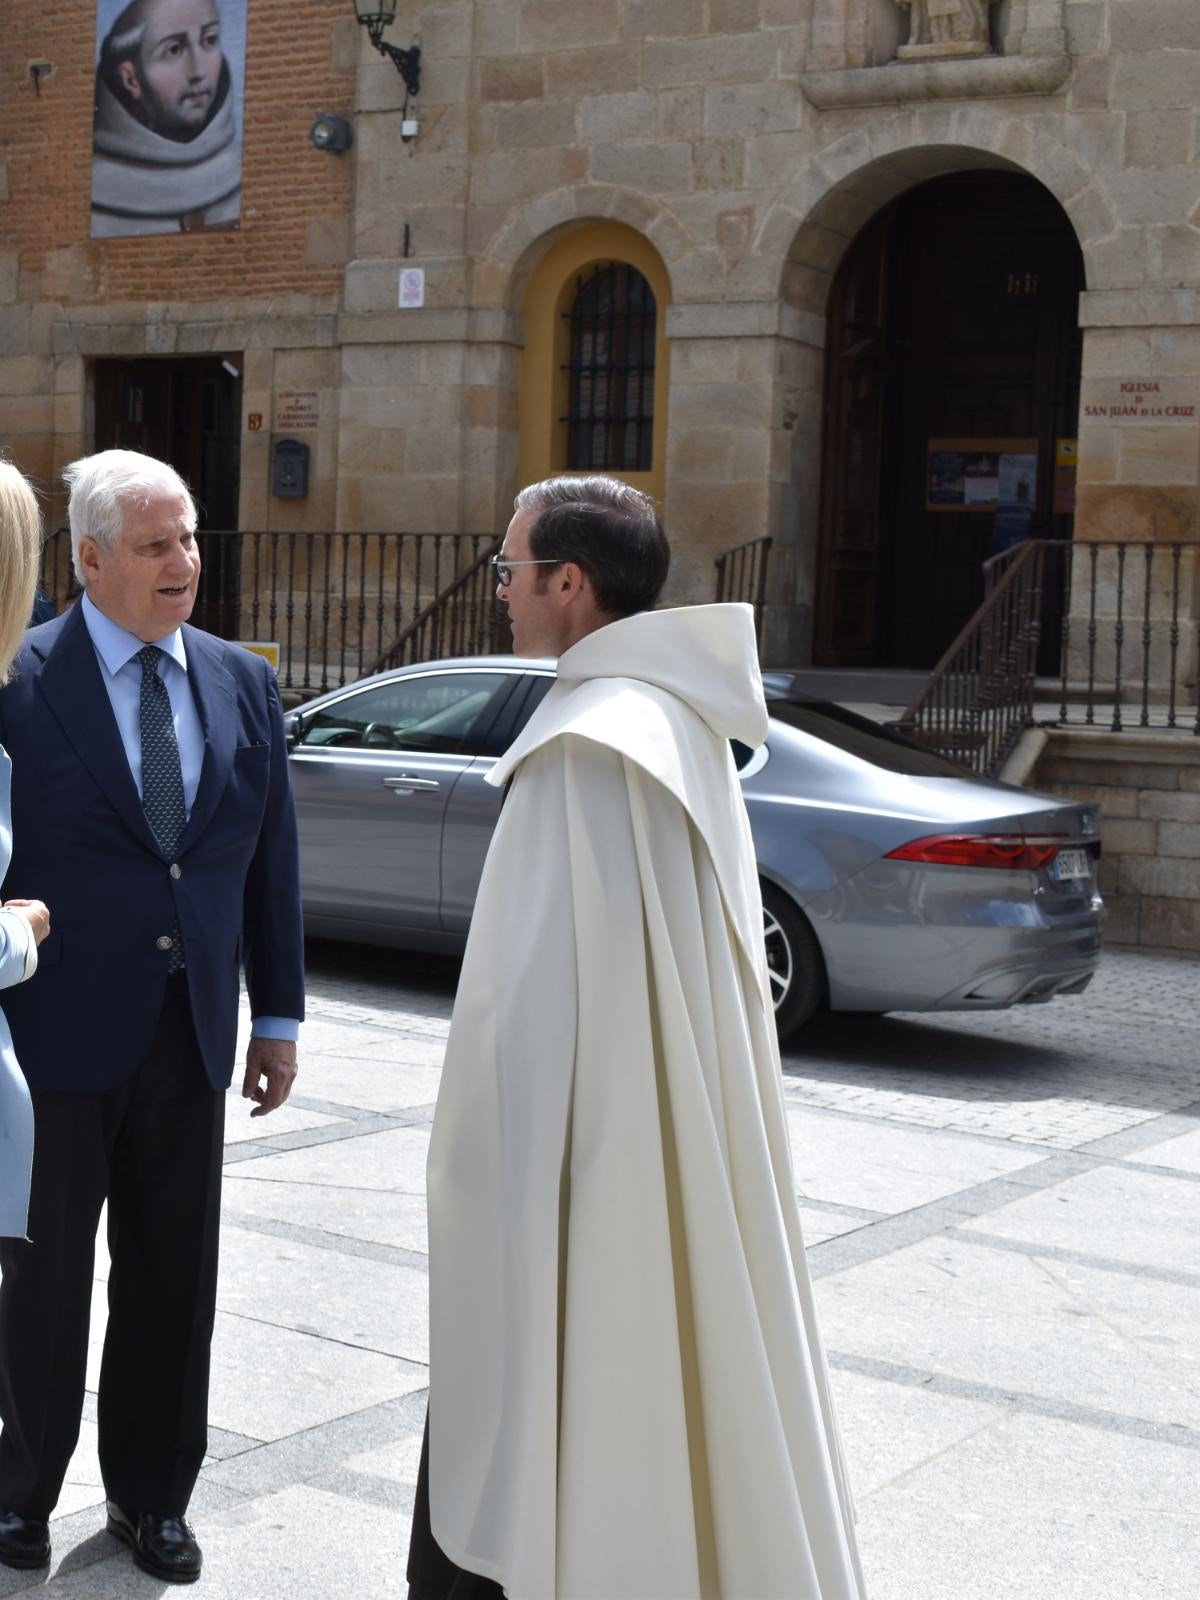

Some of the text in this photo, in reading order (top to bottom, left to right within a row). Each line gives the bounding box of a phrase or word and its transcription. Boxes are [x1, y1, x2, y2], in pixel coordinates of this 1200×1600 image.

[1120, 382, 1160, 393] IGLESIA
[1084, 406, 1107, 416] SAN
[1109, 406, 1138, 418] JUAN
[1151, 407, 1163, 416] LA
[1165, 406, 1195, 416] CRUZ
